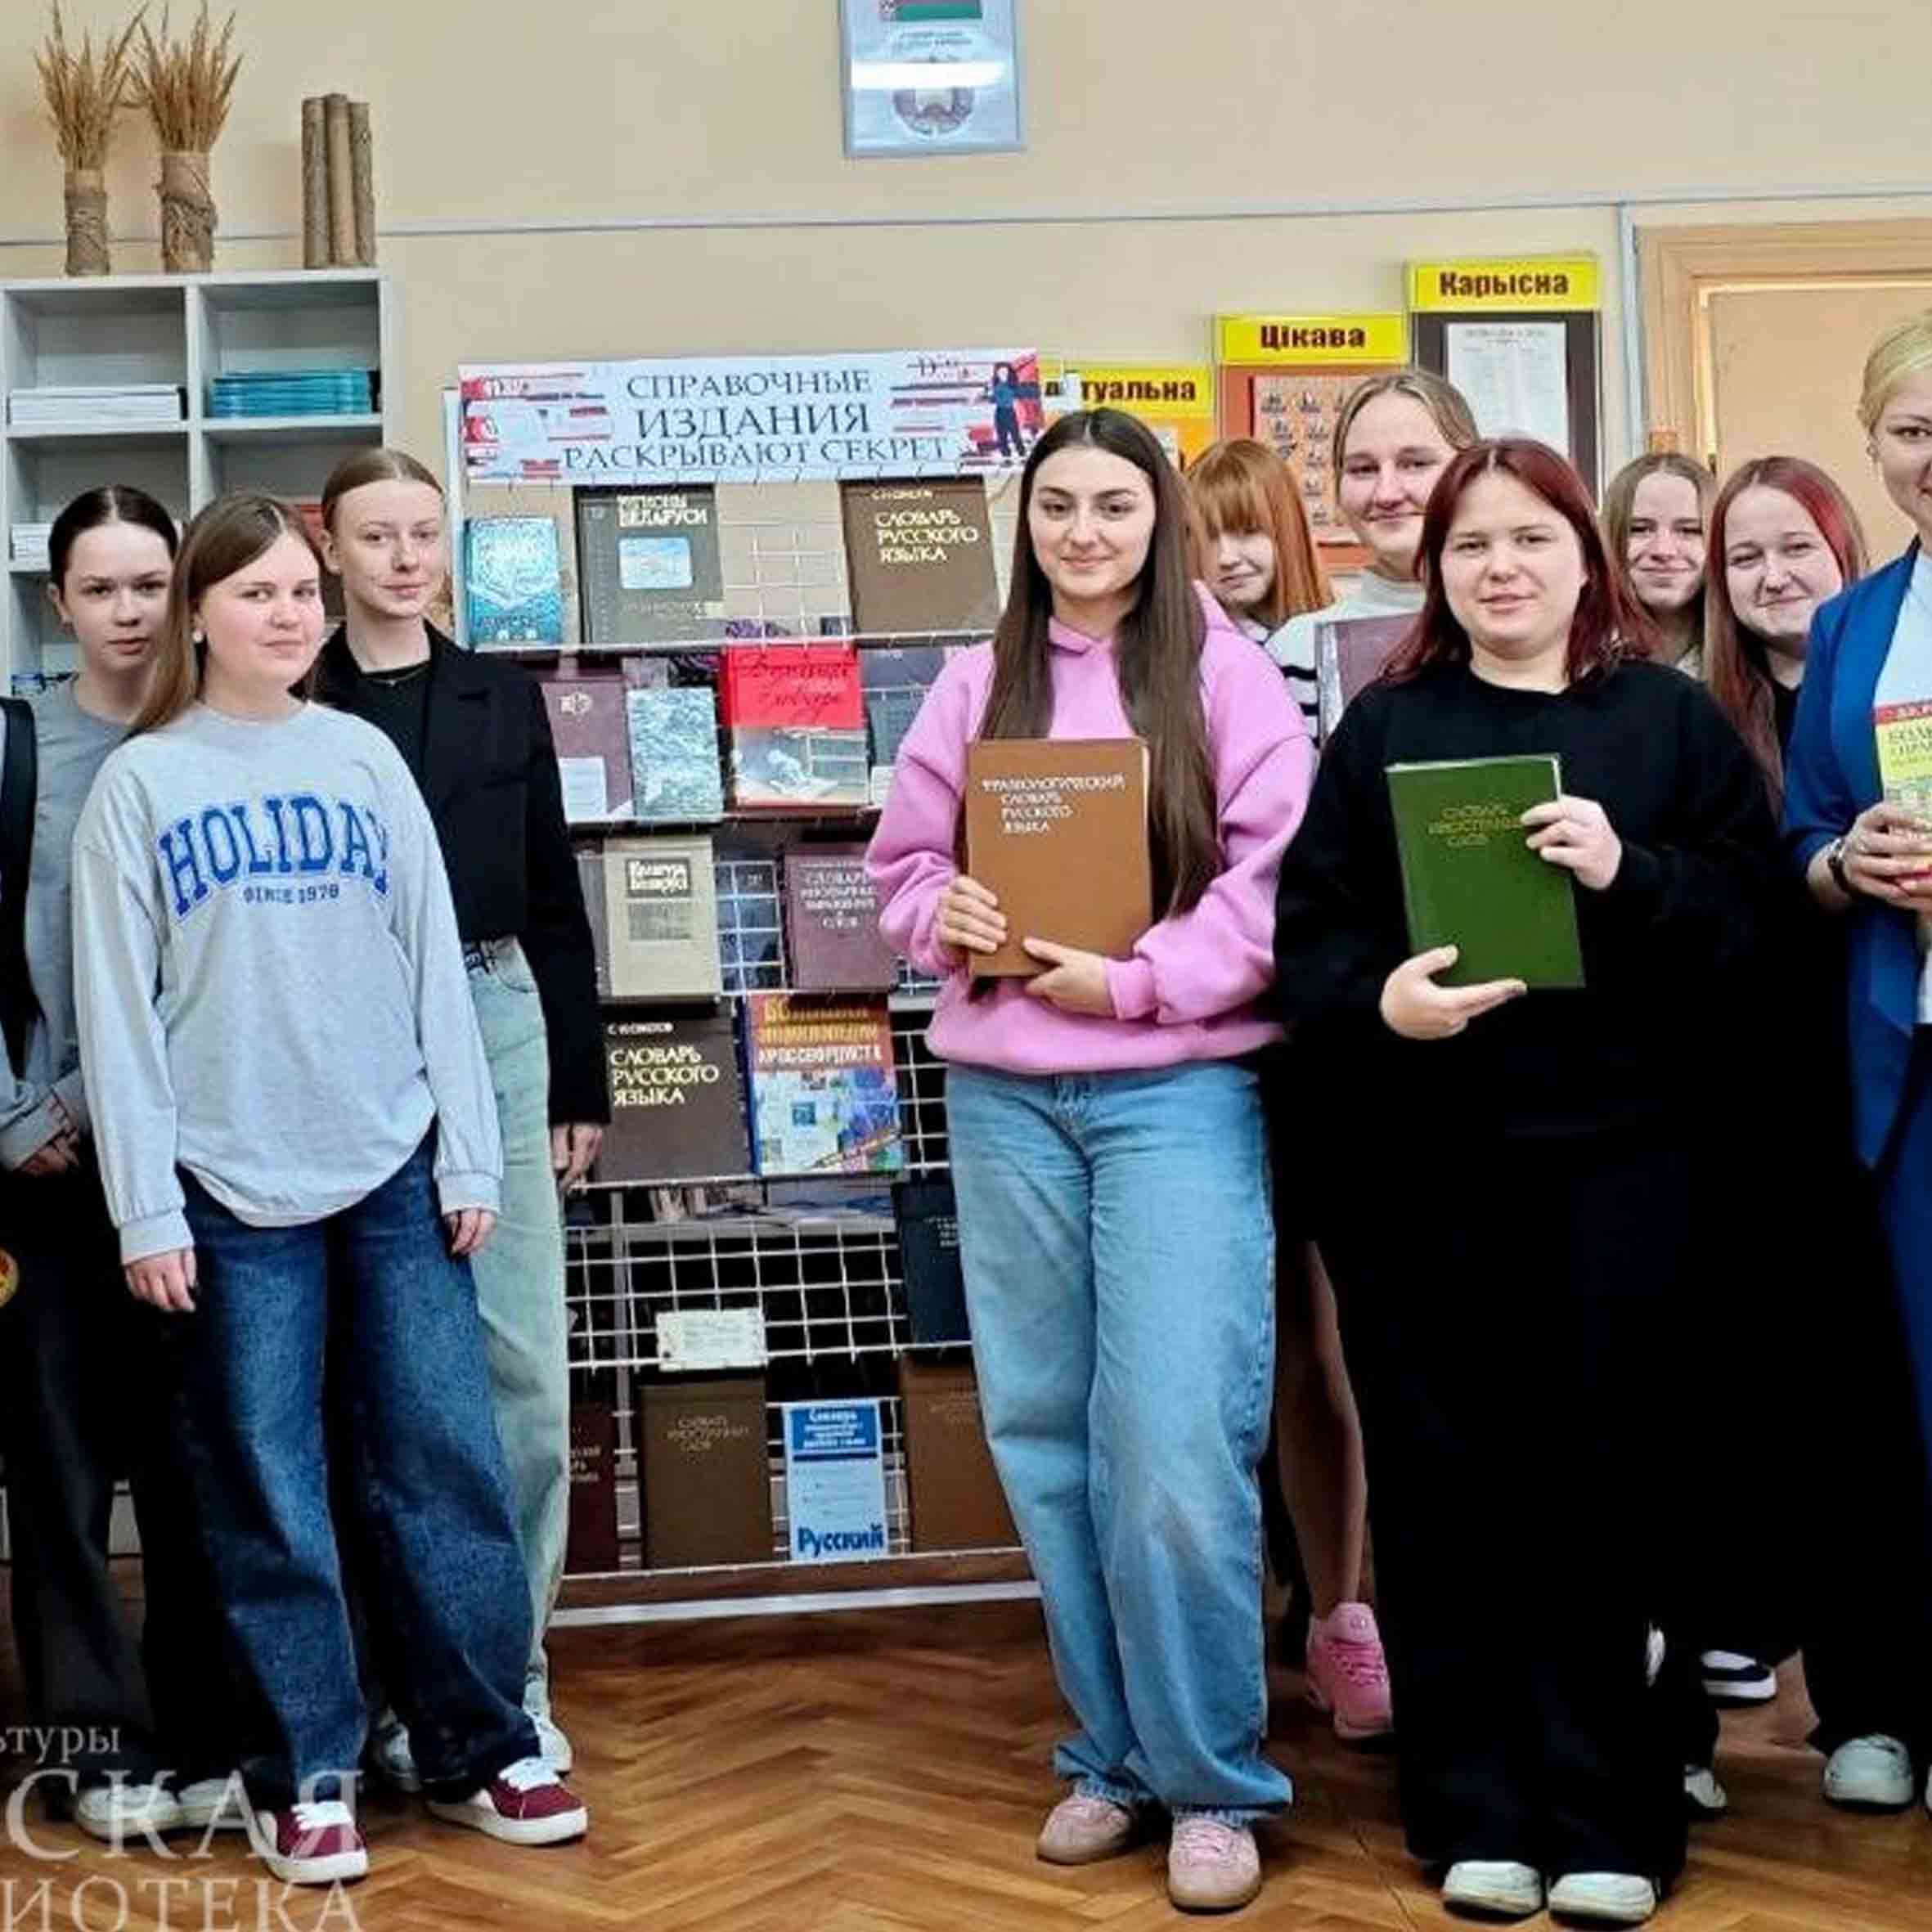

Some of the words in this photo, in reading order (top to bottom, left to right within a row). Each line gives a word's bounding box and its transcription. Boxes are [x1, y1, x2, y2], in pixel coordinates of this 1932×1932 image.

[1439, 272, 1569, 298] Карысна
[1260, 325, 1366, 350] Цікава
[627, 370, 872, 399] СПРАВОЧНЫЕ
[636, 402, 869, 443] ИЗДАНИЯ
[564, 442, 811, 469] РАСКРЫВАЮТ
[820, 437, 947, 463] СЕКРЕТ
[875, 508, 962, 528] СЛОВАРЬ
[878, 527, 978, 546] РУССКОГО
[880, 546, 948, 563] ЯЗЫКА
[242, 886, 292, 904] SINCE
[610, 1045, 702, 1065] СЛОВАРЬ
[613, 1064, 719, 1086] РУССКОГО
[613, 1087, 685, 1106] ЯЗЫКА
[798, 1522, 884, 1558] Русский
